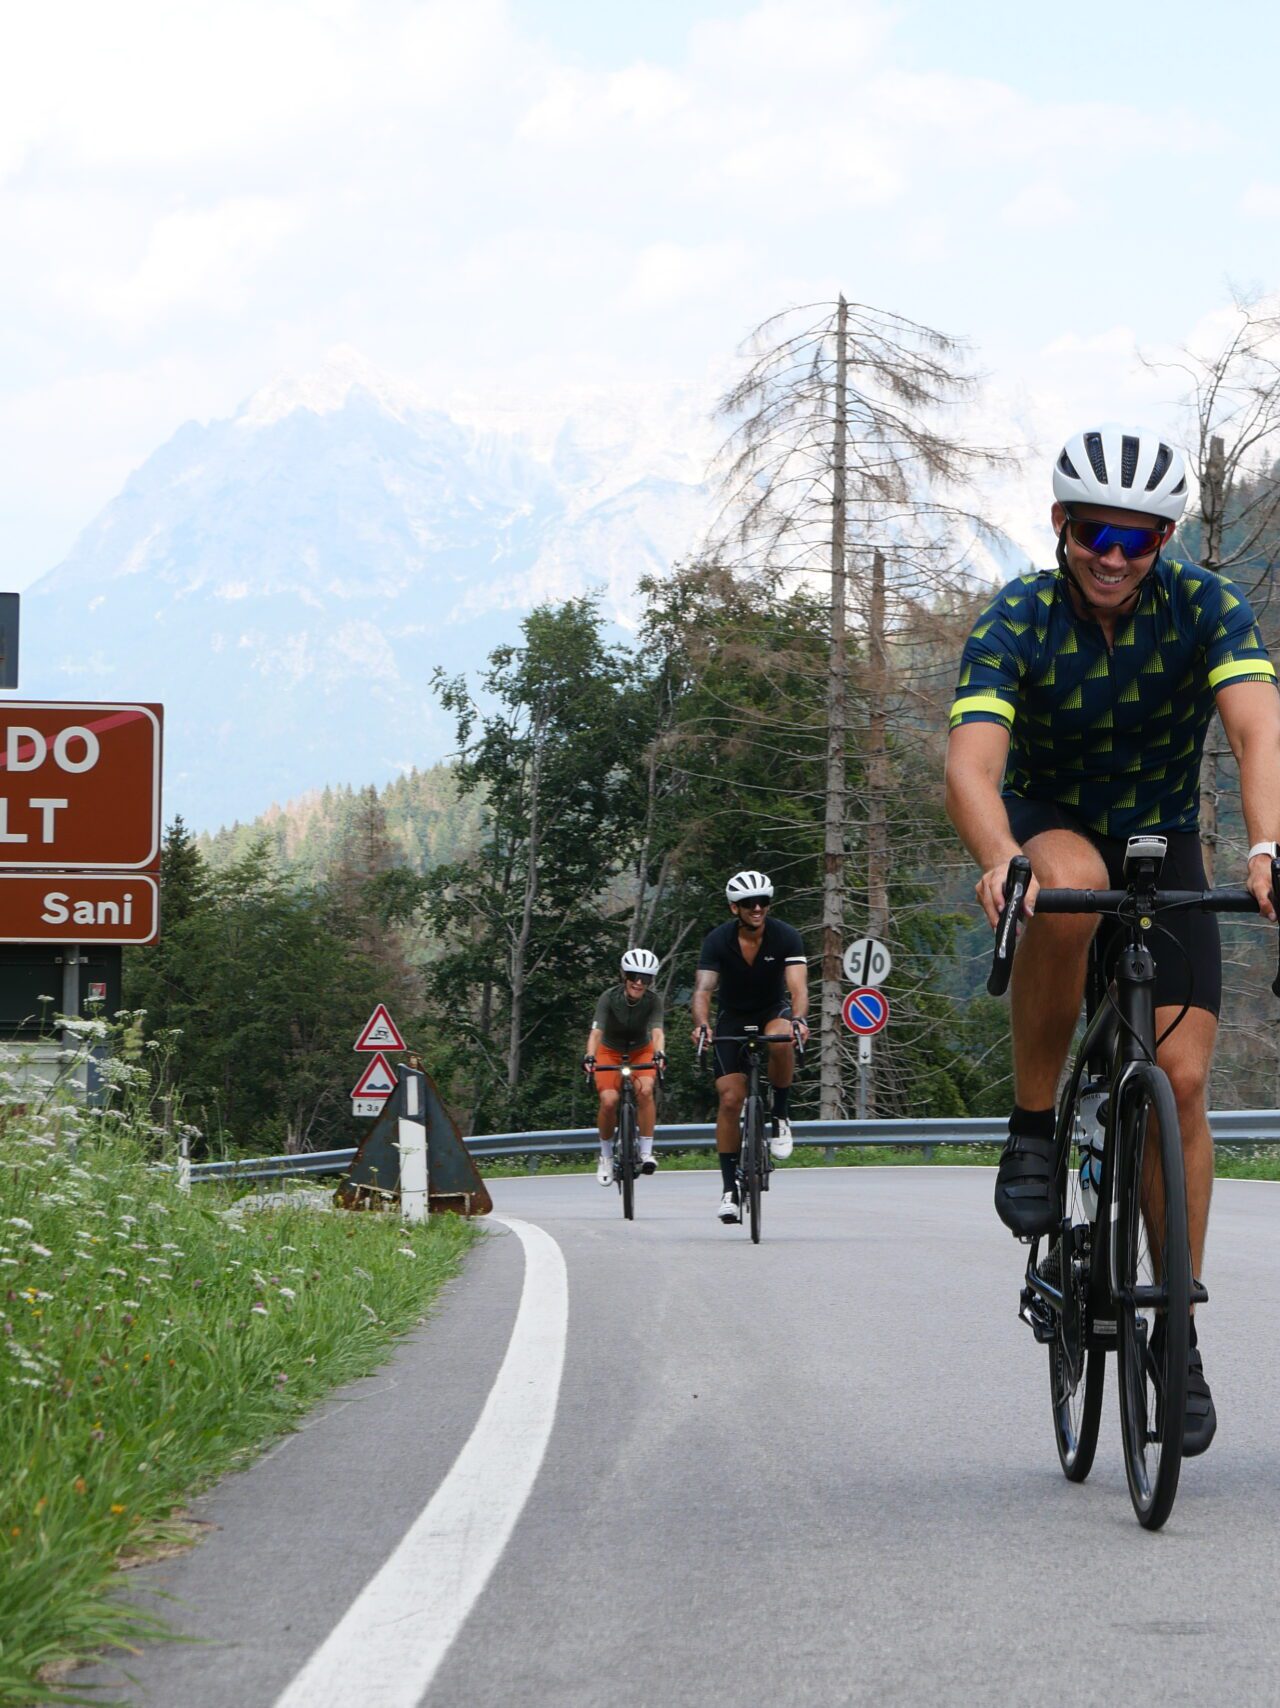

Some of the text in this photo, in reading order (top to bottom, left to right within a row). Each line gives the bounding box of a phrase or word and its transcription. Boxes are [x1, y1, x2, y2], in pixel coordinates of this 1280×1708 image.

[7, 726, 100, 774] DO
[0, 797, 69, 843] LT
[40, 892, 133, 925] Sani
[849, 951, 885, 974] 50
